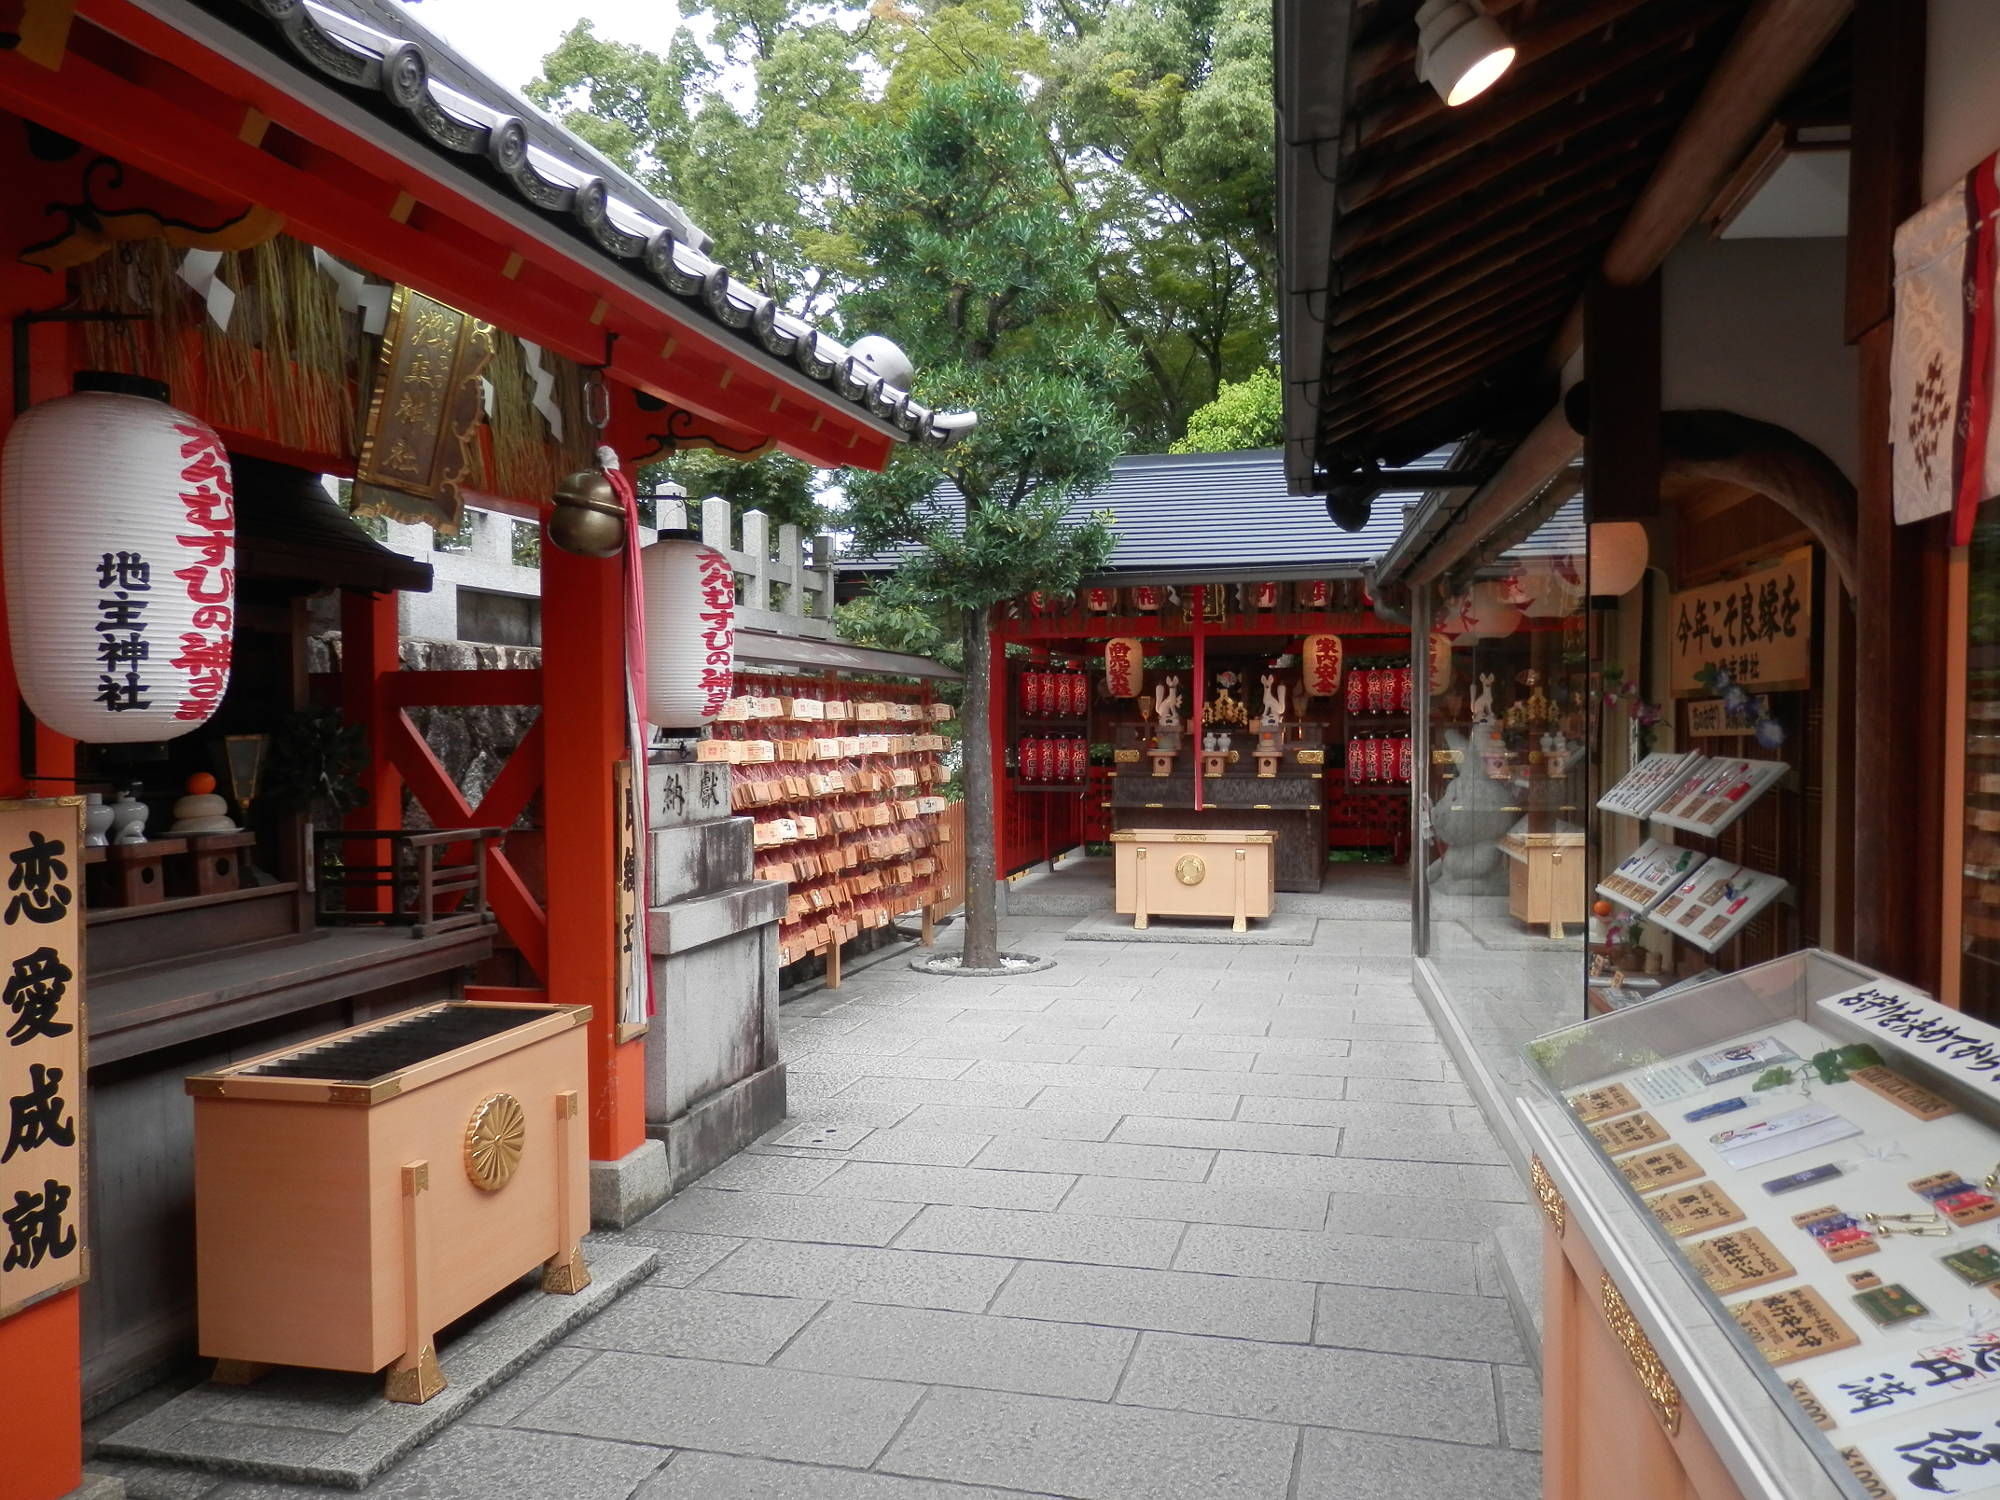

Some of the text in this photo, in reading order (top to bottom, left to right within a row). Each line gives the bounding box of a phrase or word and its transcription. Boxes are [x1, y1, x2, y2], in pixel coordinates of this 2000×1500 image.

[94, 550, 153, 712] 地主神社
[1676, 573, 1801, 657] 今年こそ良縁を
[1312, 637, 1338, 693] 家内安全
[1, 830, 77, 1272] 恋愛成就
[1787, 1381, 1827, 1423] ¥1000
[1840, 1448, 1888, 1499] ¥1000
